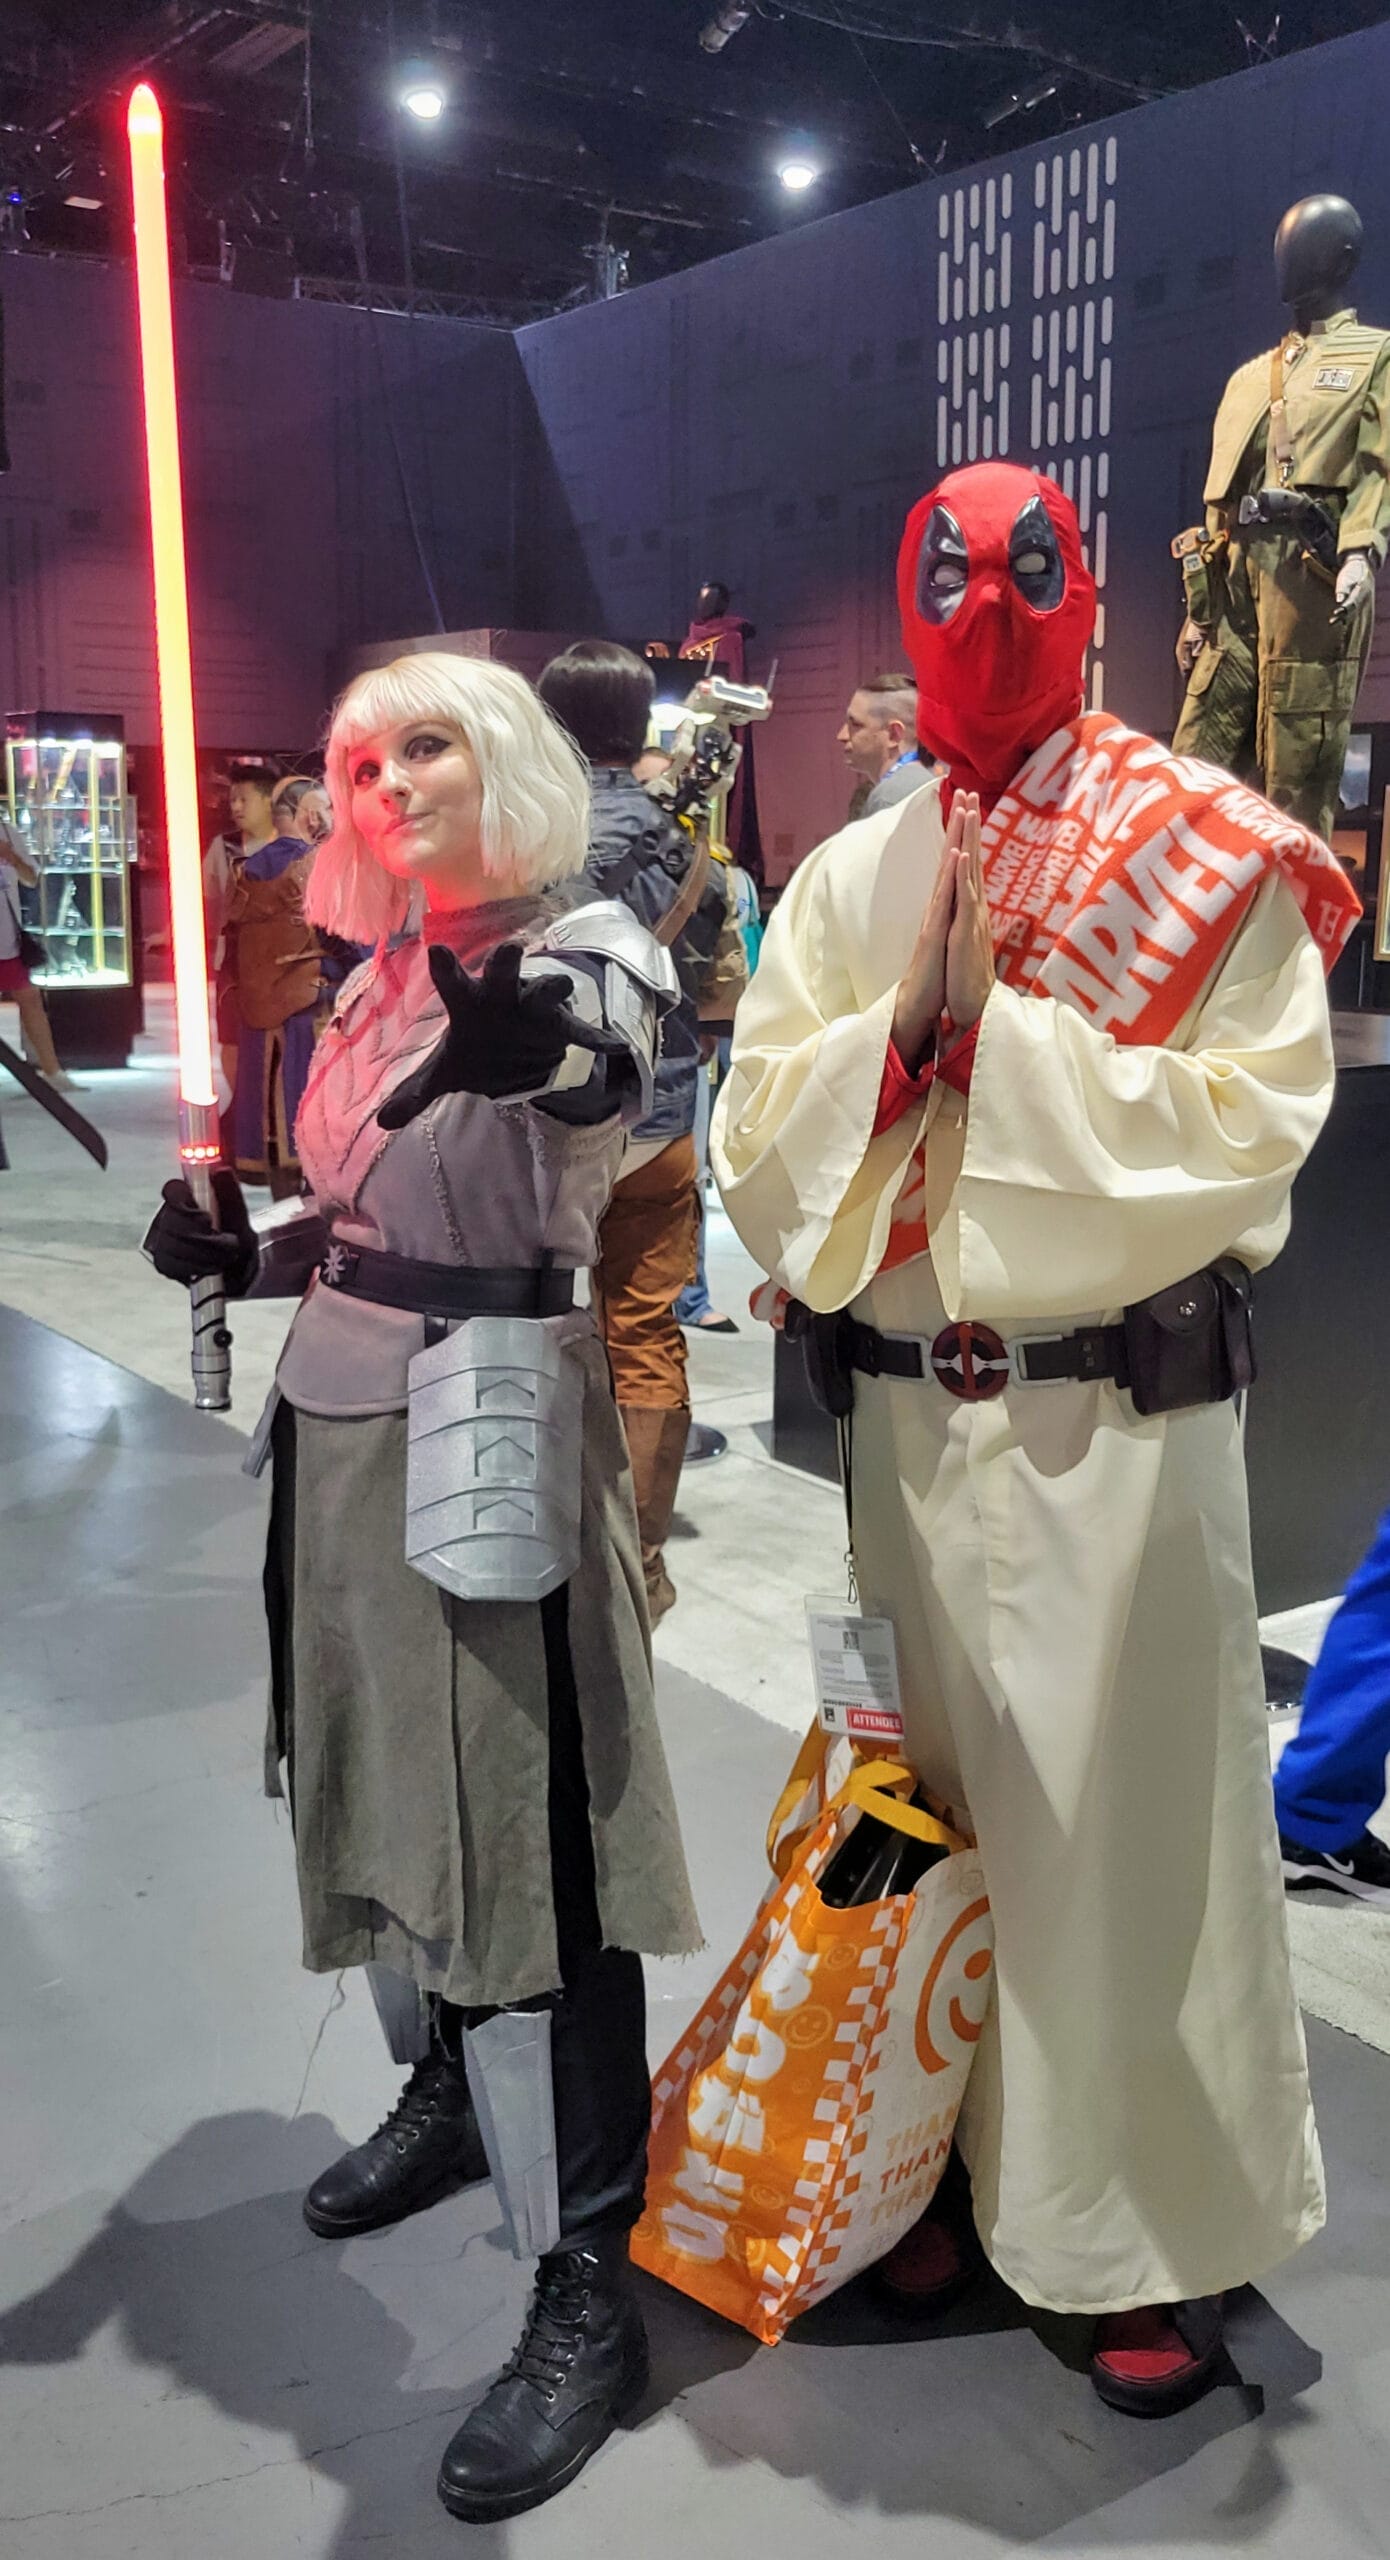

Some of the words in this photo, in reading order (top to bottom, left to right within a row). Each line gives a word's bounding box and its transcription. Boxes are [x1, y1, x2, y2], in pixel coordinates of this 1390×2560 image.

[1008, 728, 1172, 842] MARVL
[1036, 811, 1262, 1029] ARVEL
[852, 1711, 901, 1729] ATTENDEE
[884, 2104, 958, 2161] THAN
[879, 2136, 951, 2194] THAN
[870, 2170, 940, 2226] THAN
